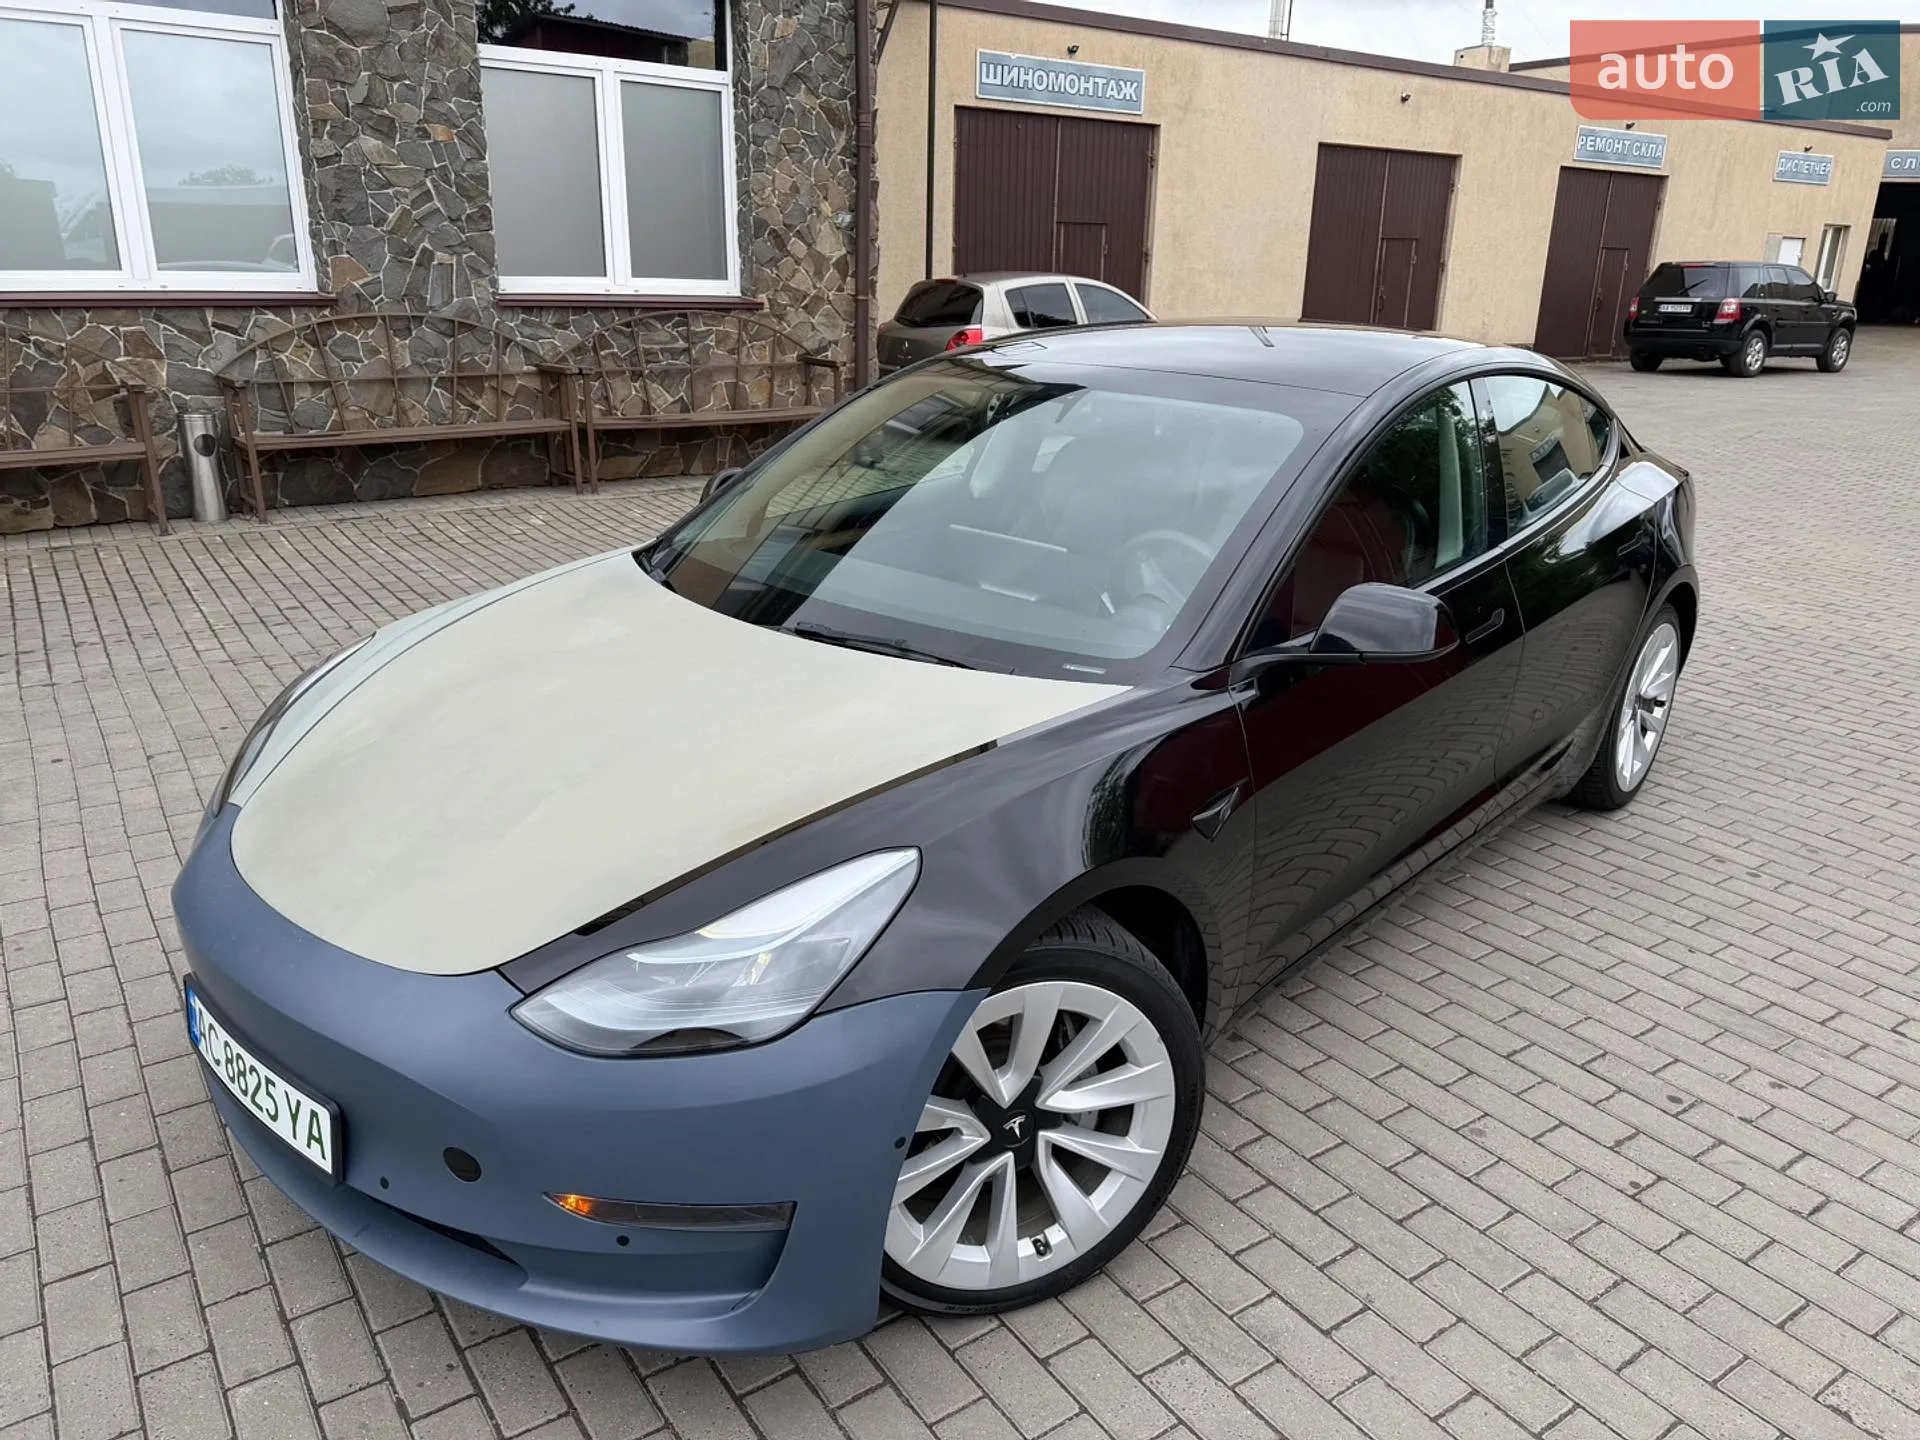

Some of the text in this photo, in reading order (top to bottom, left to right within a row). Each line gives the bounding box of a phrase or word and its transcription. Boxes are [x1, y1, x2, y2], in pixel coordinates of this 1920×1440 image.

[981, 62, 1138, 101] ШИНОМОНТАЖ
[1578, 135, 1663, 158] РЕМОНТ СКЛА
[223, 1039, 279, 1123] 8825
[284, 1089, 327, 1161] YA
